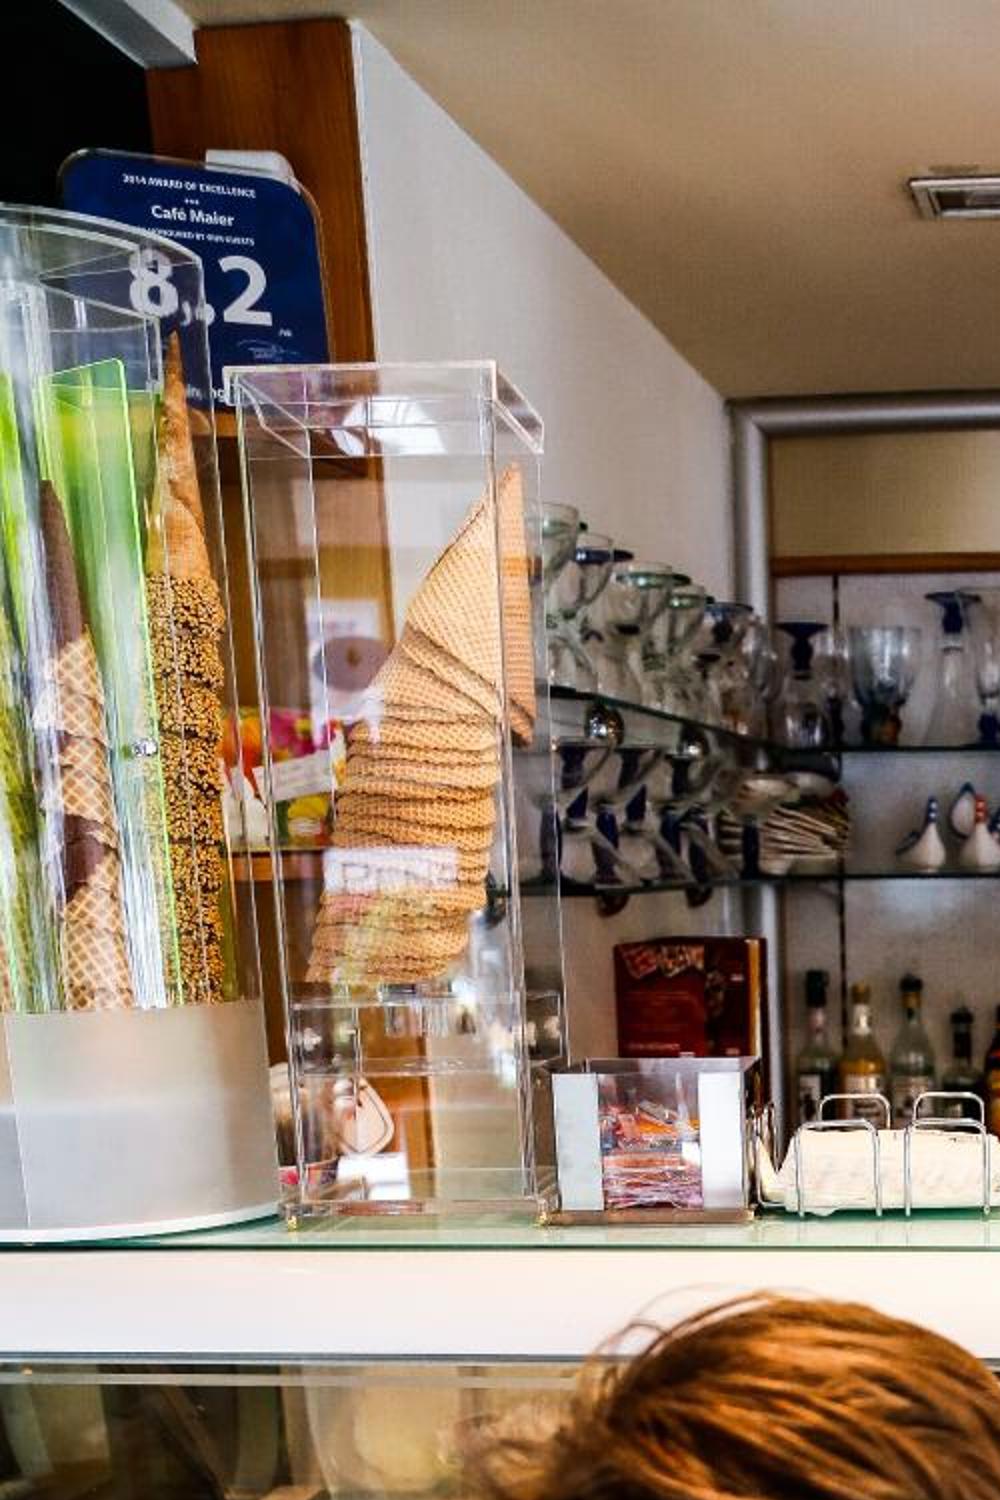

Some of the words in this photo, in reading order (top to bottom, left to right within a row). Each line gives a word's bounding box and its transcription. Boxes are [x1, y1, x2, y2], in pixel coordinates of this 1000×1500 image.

[123, 174, 147, 185] 2014
[148, 177, 183, 190] AWARD
[184, 181, 196, 191] OF
[199, 184, 256, 198] EXCELLENCE
[151, 204, 187, 222] Café
[190, 209, 235, 226] Maier
